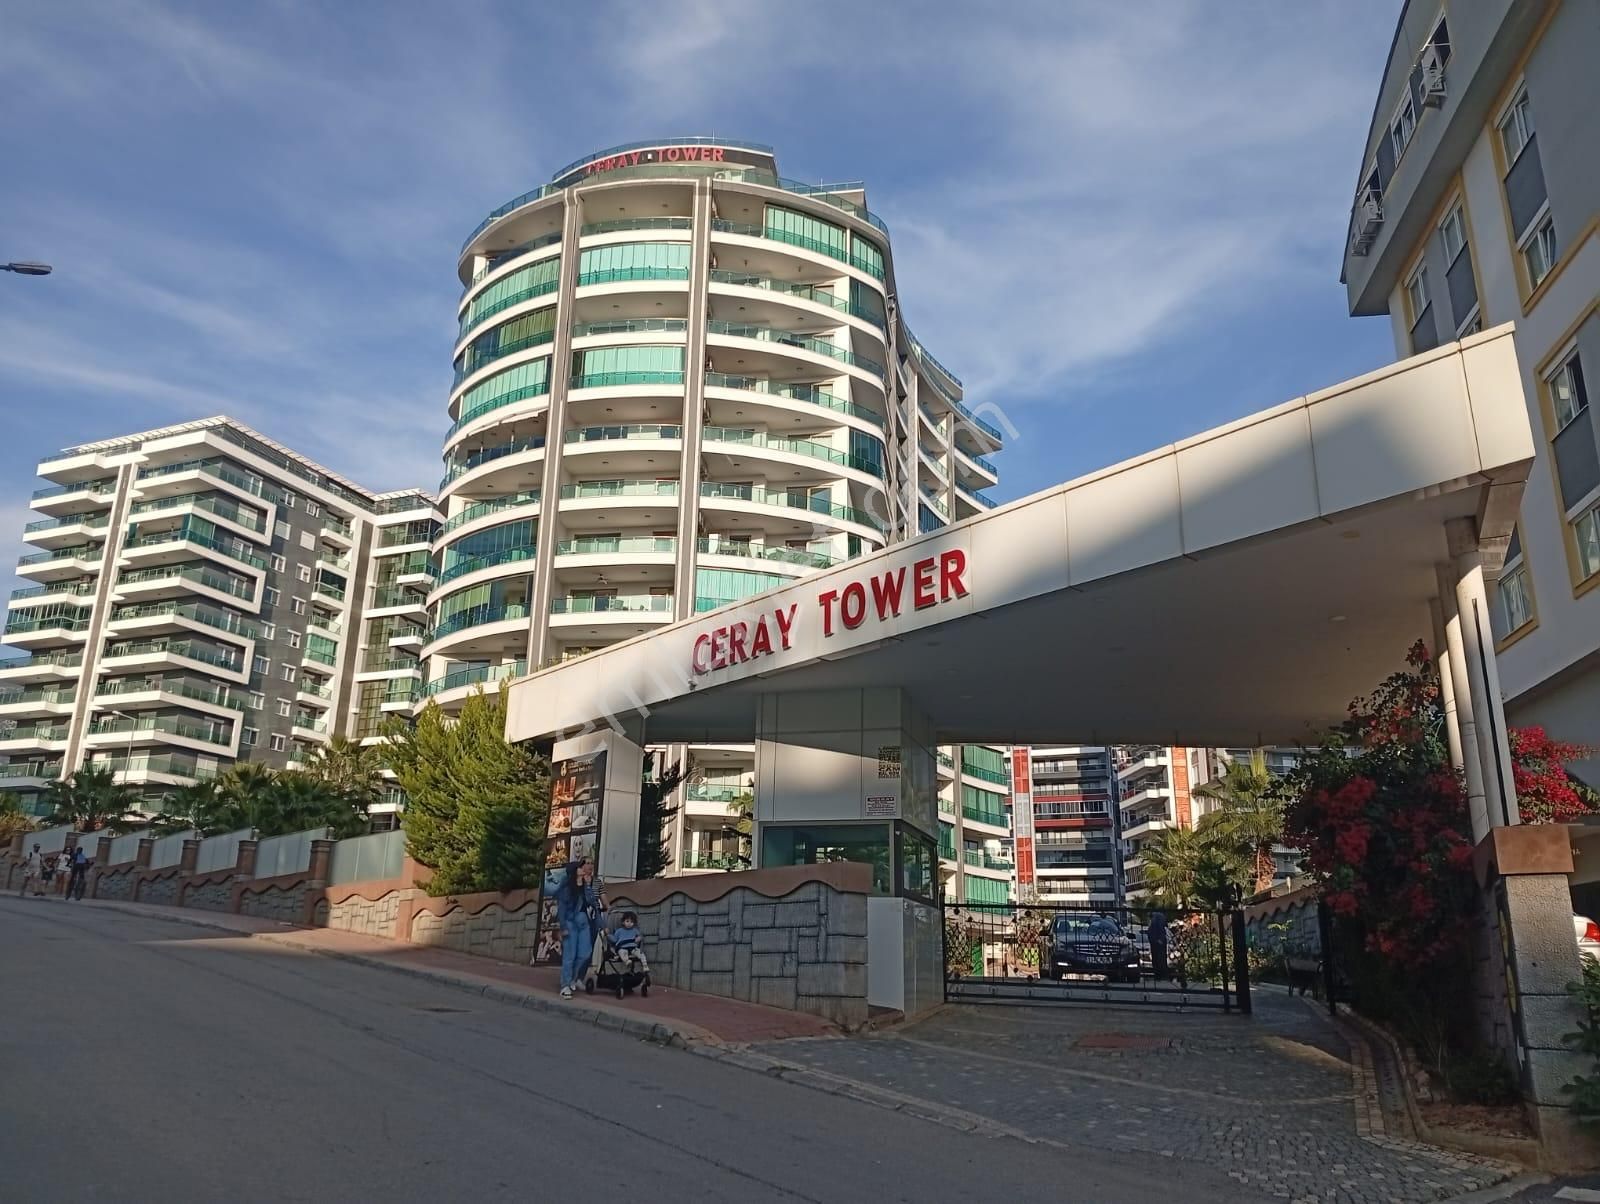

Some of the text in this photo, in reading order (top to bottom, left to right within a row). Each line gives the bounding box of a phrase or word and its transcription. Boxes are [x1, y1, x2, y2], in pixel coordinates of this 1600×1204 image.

[657, 147, 724, 162] TOWER
[692, 549, 969, 675] CERAY TOWER
